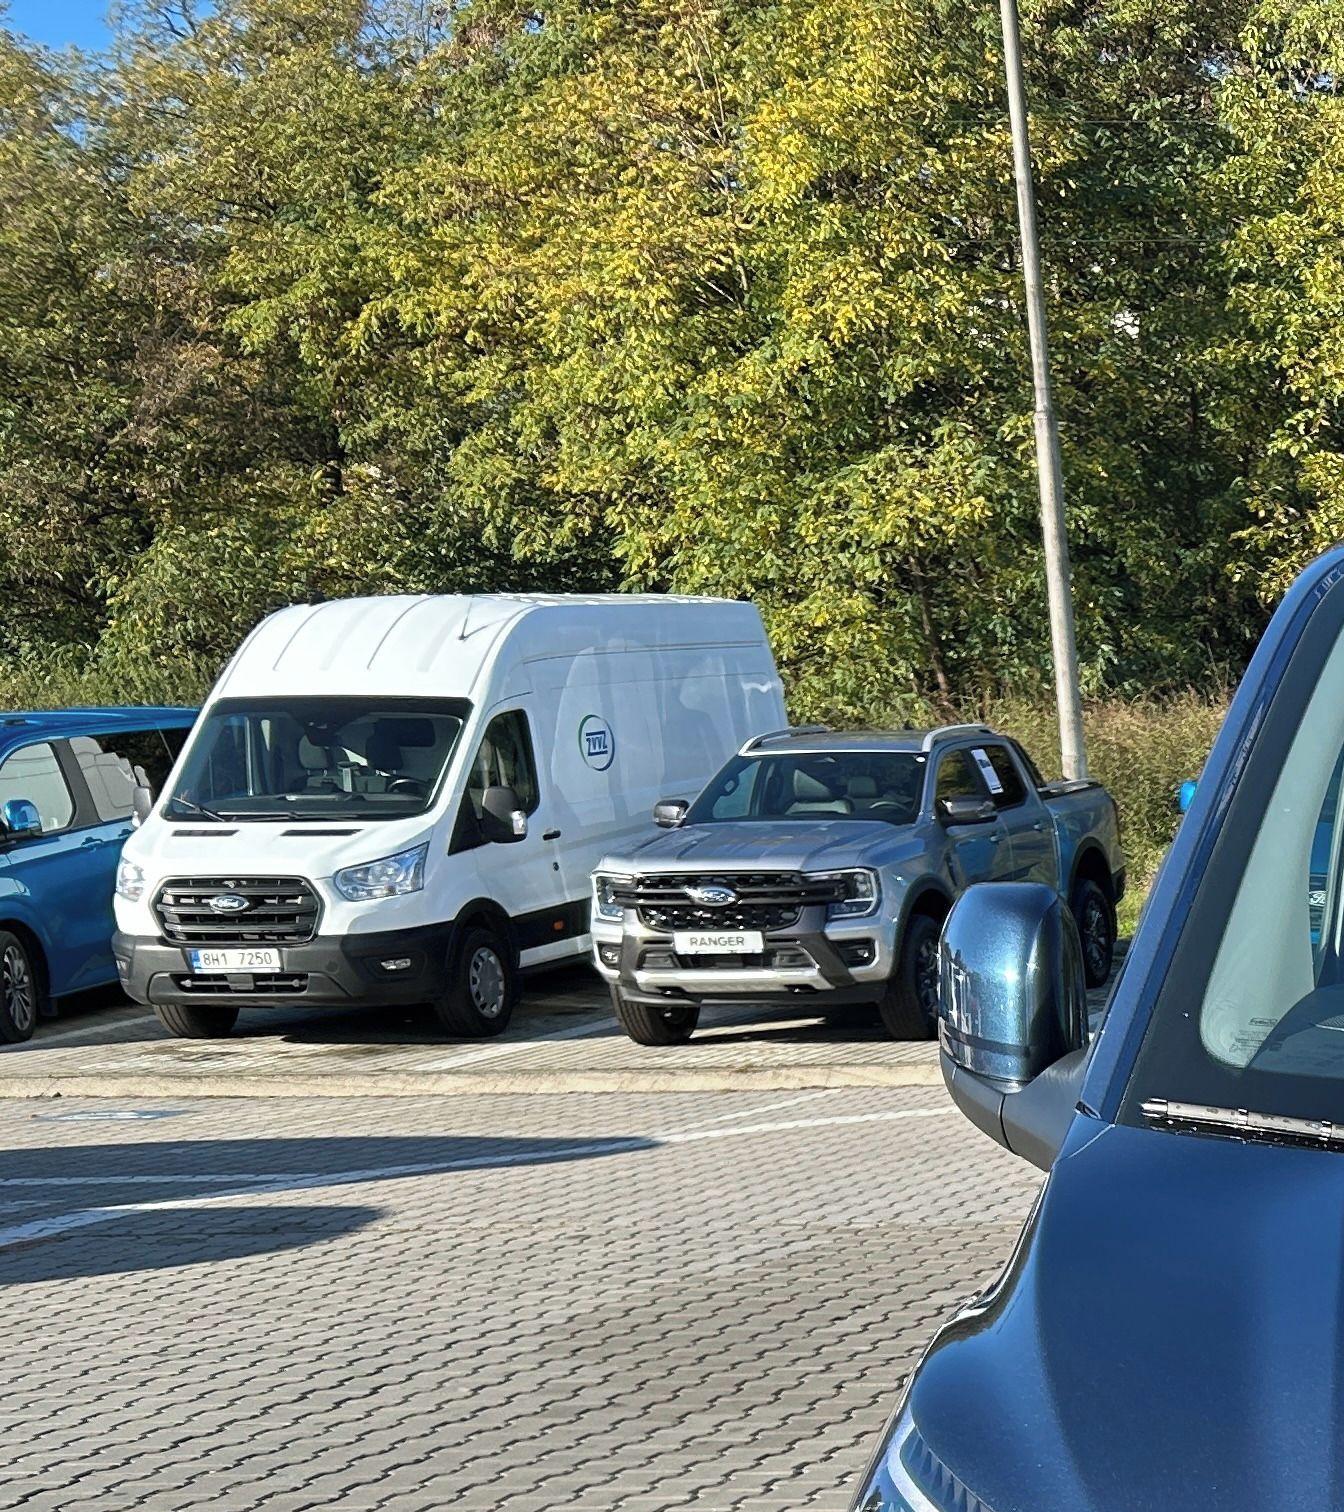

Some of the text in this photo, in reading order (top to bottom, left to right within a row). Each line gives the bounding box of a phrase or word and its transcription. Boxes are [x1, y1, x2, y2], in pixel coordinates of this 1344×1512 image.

[689, 936, 745, 947] RANGER
[202, 953, 228, 967] 8H1
[239, 951, 273, 966] 7250
